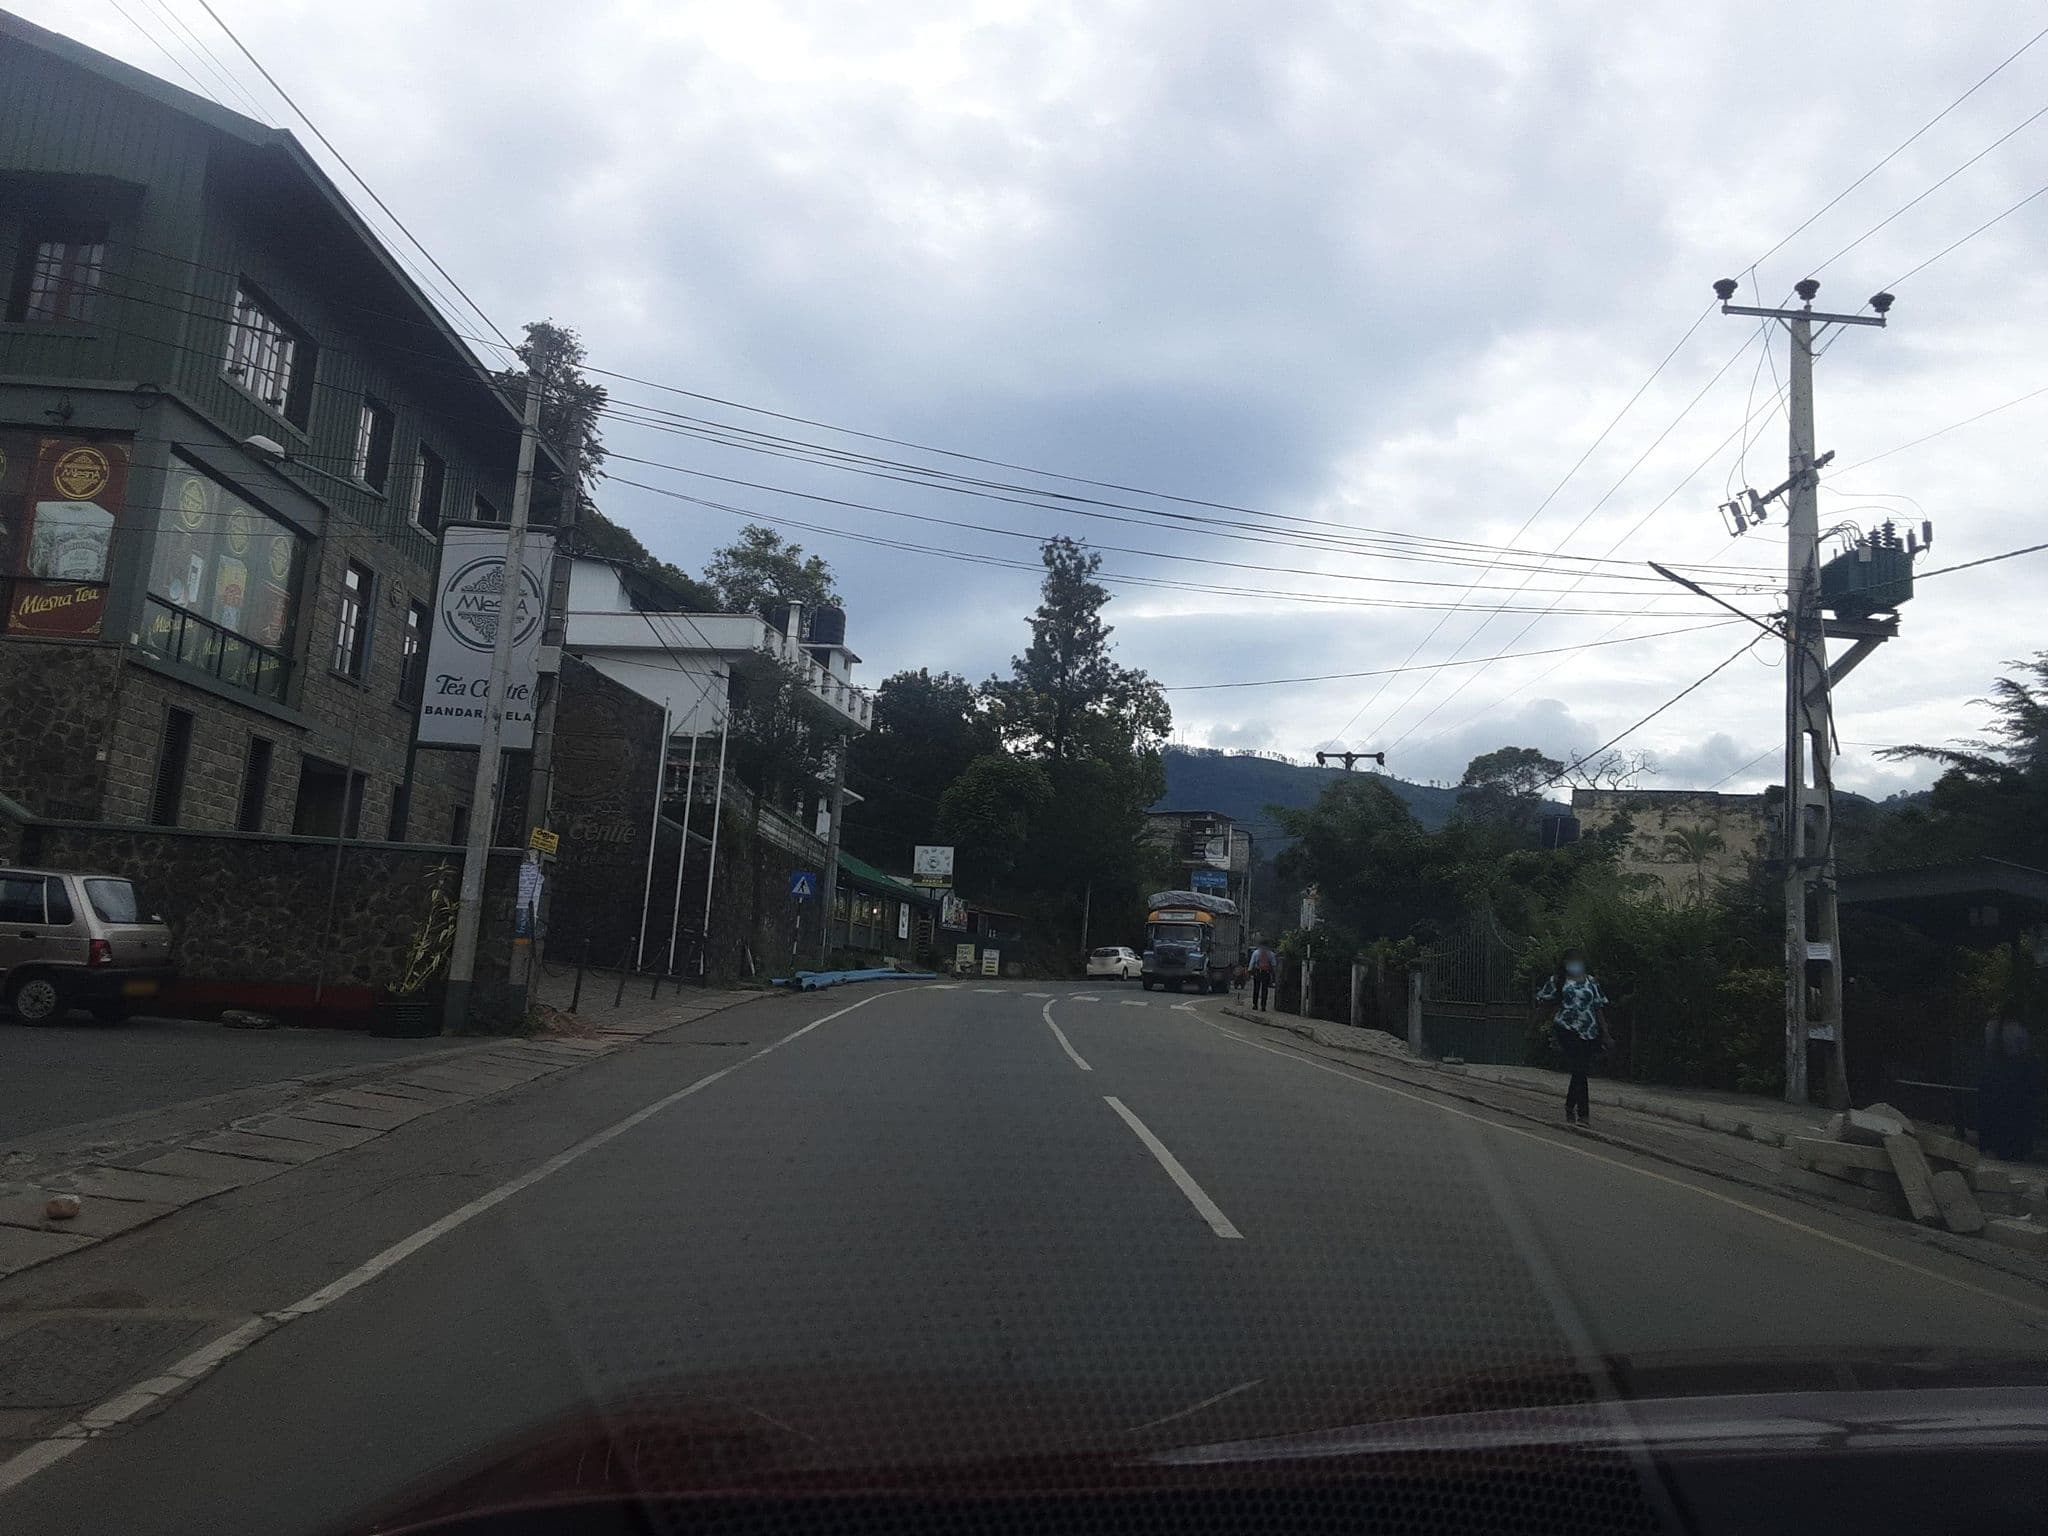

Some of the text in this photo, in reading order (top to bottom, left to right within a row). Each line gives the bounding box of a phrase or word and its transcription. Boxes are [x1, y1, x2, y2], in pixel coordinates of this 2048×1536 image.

[18, 586, 99, 615] Mlesna Tea
[435, 674, 529, 701] Tea Cetre
[424, 705, 532, 722] BANDARELA
